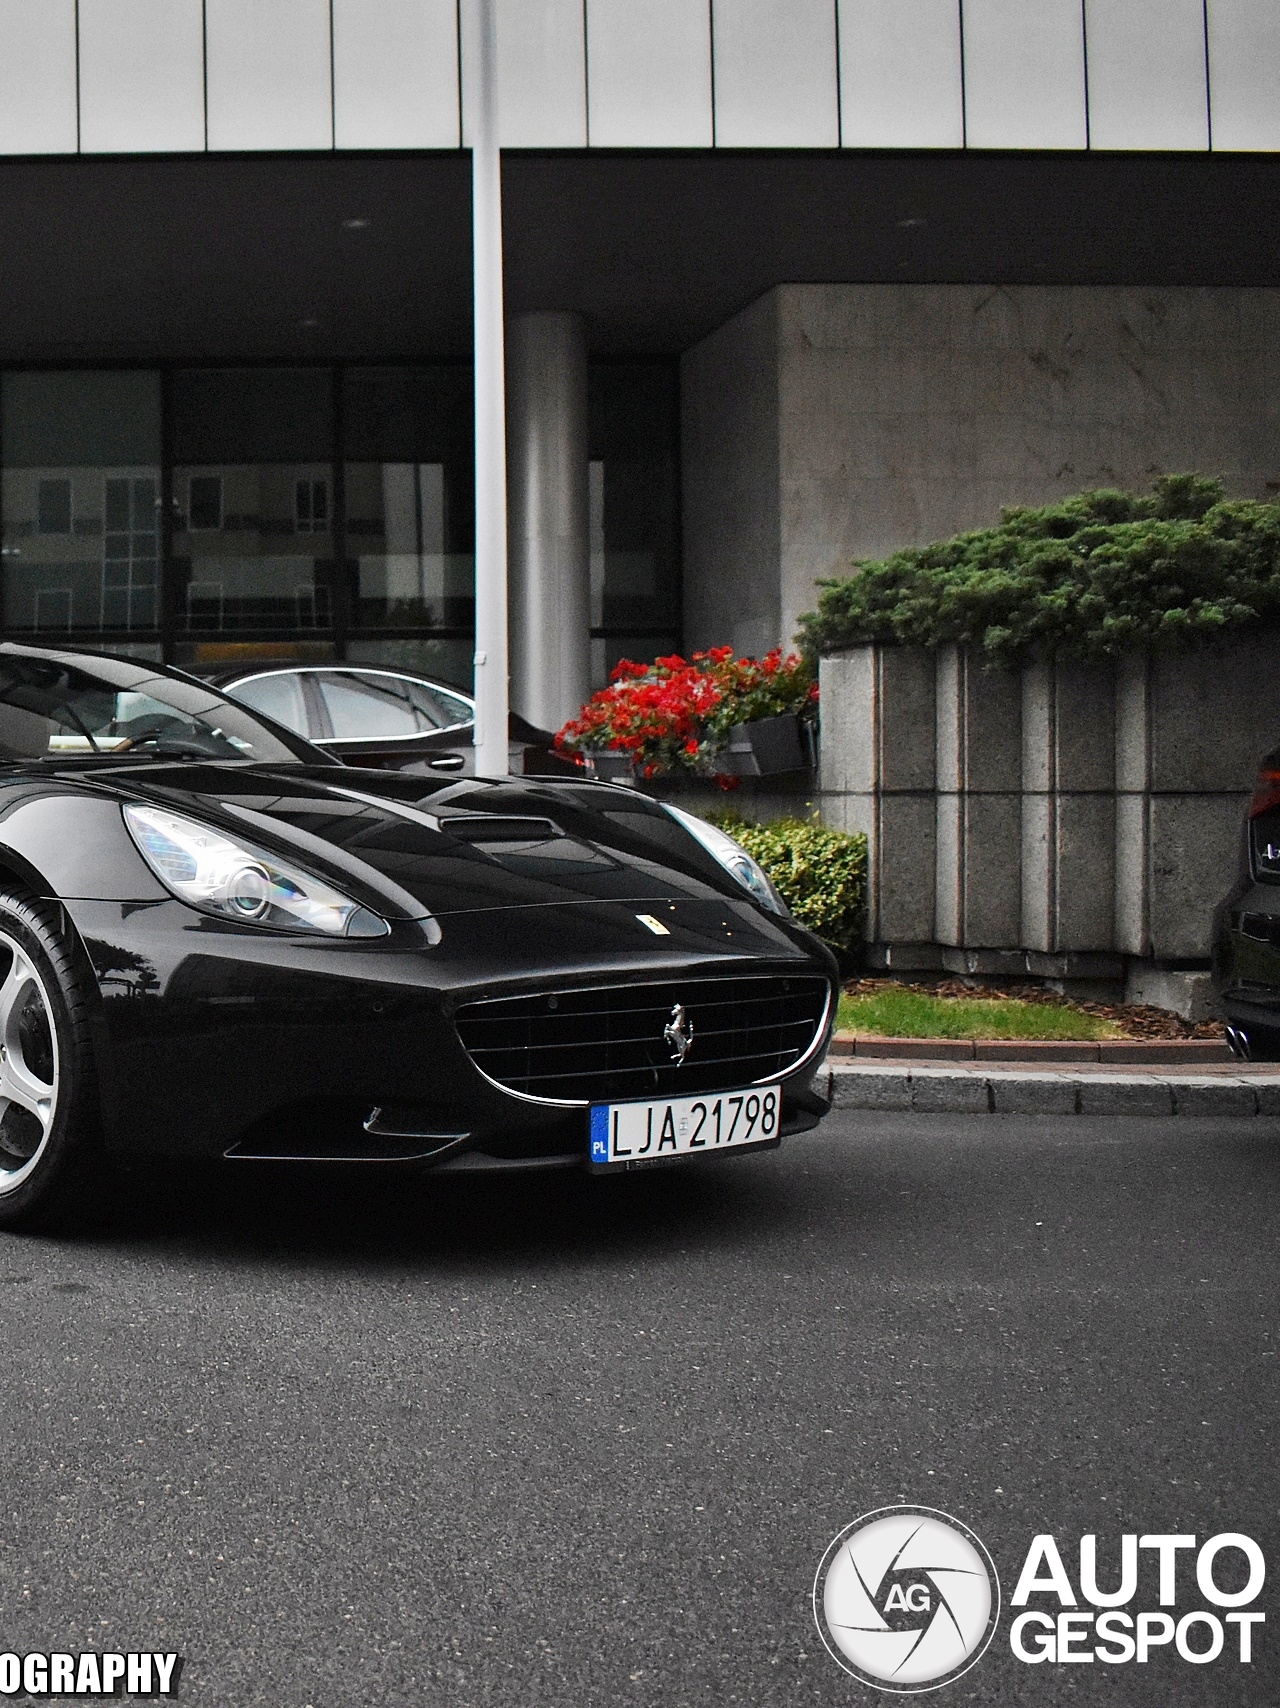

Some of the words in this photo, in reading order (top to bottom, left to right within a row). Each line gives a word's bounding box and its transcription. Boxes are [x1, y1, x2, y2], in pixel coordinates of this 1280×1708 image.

[613, 1105, 677, 1156] LJA
[690, 1092, 775, 1147] 21798
[593, 1142, 607, 1154] PL
